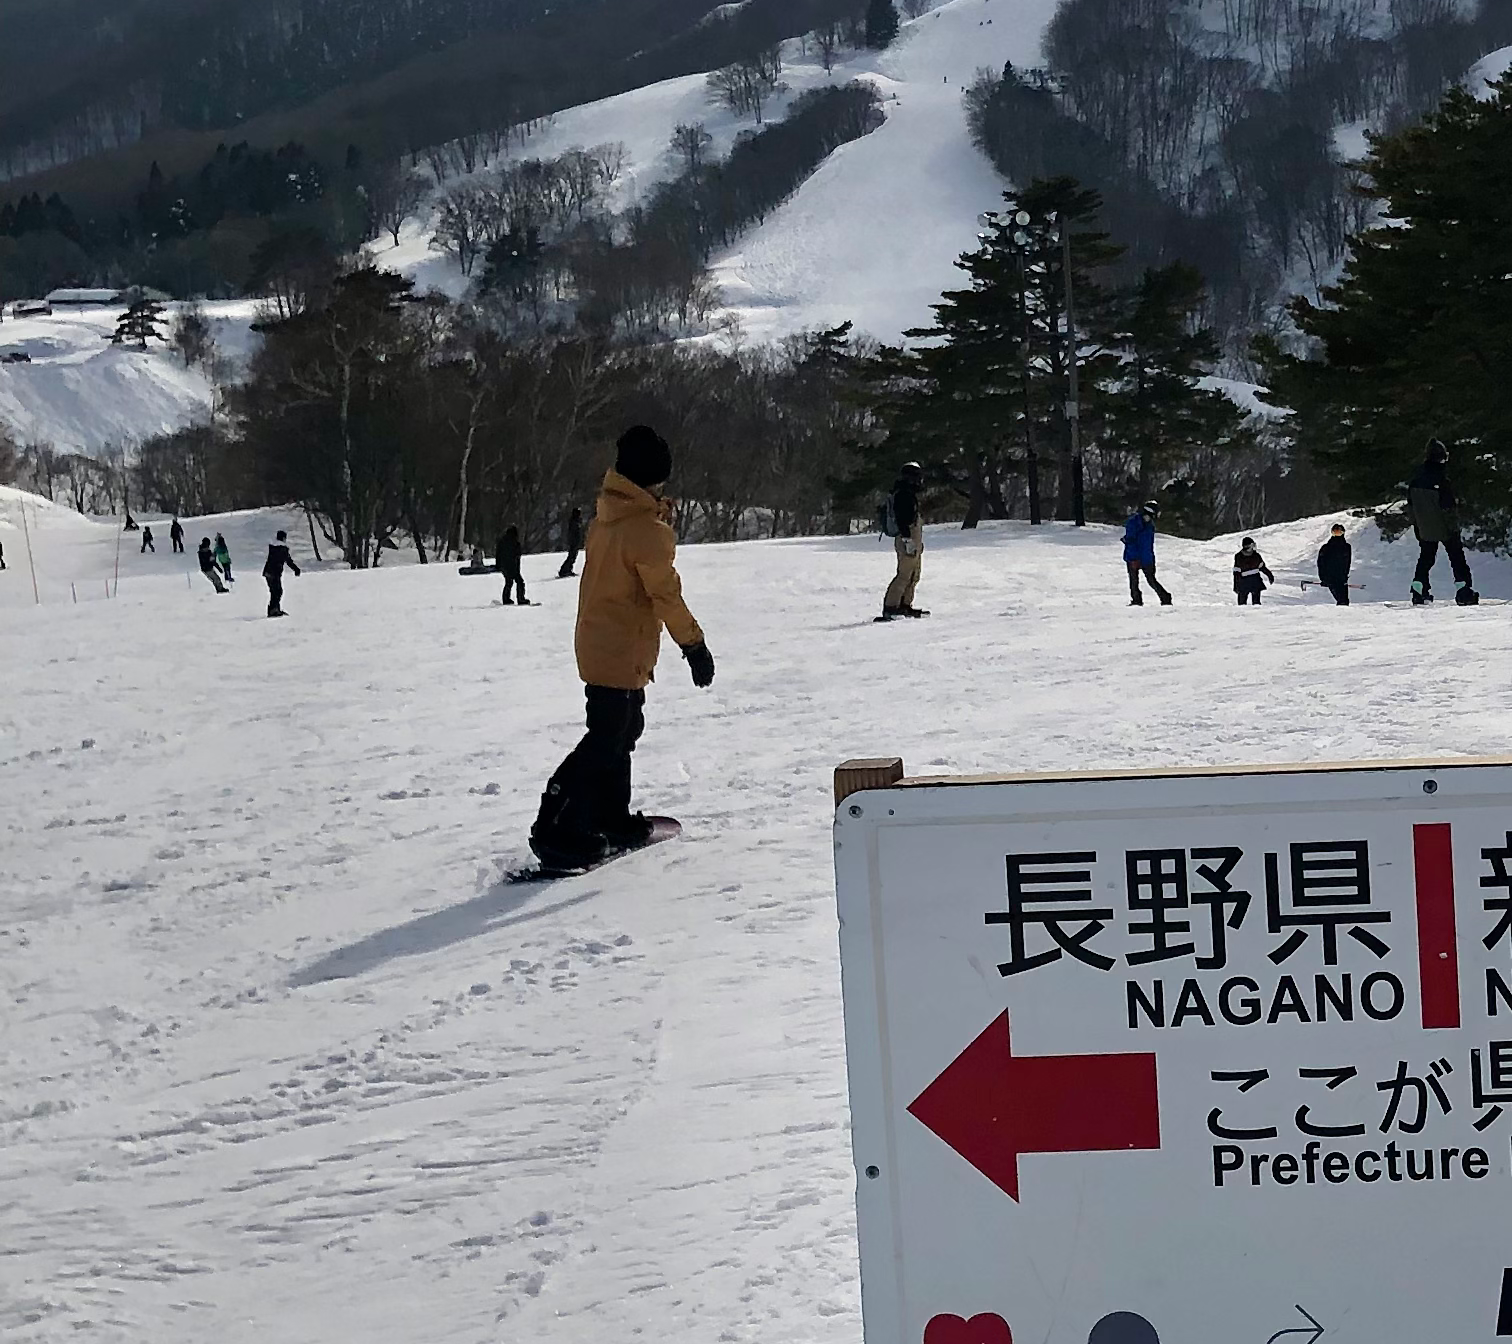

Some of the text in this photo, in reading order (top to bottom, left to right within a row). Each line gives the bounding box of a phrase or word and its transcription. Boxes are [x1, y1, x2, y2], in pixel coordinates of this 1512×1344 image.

[985, 840, 1392, 977] 長野県
[1126, 971, 1404, 1029] NAGANO
[1211, 1133, 1490, 1187] Prefecture
